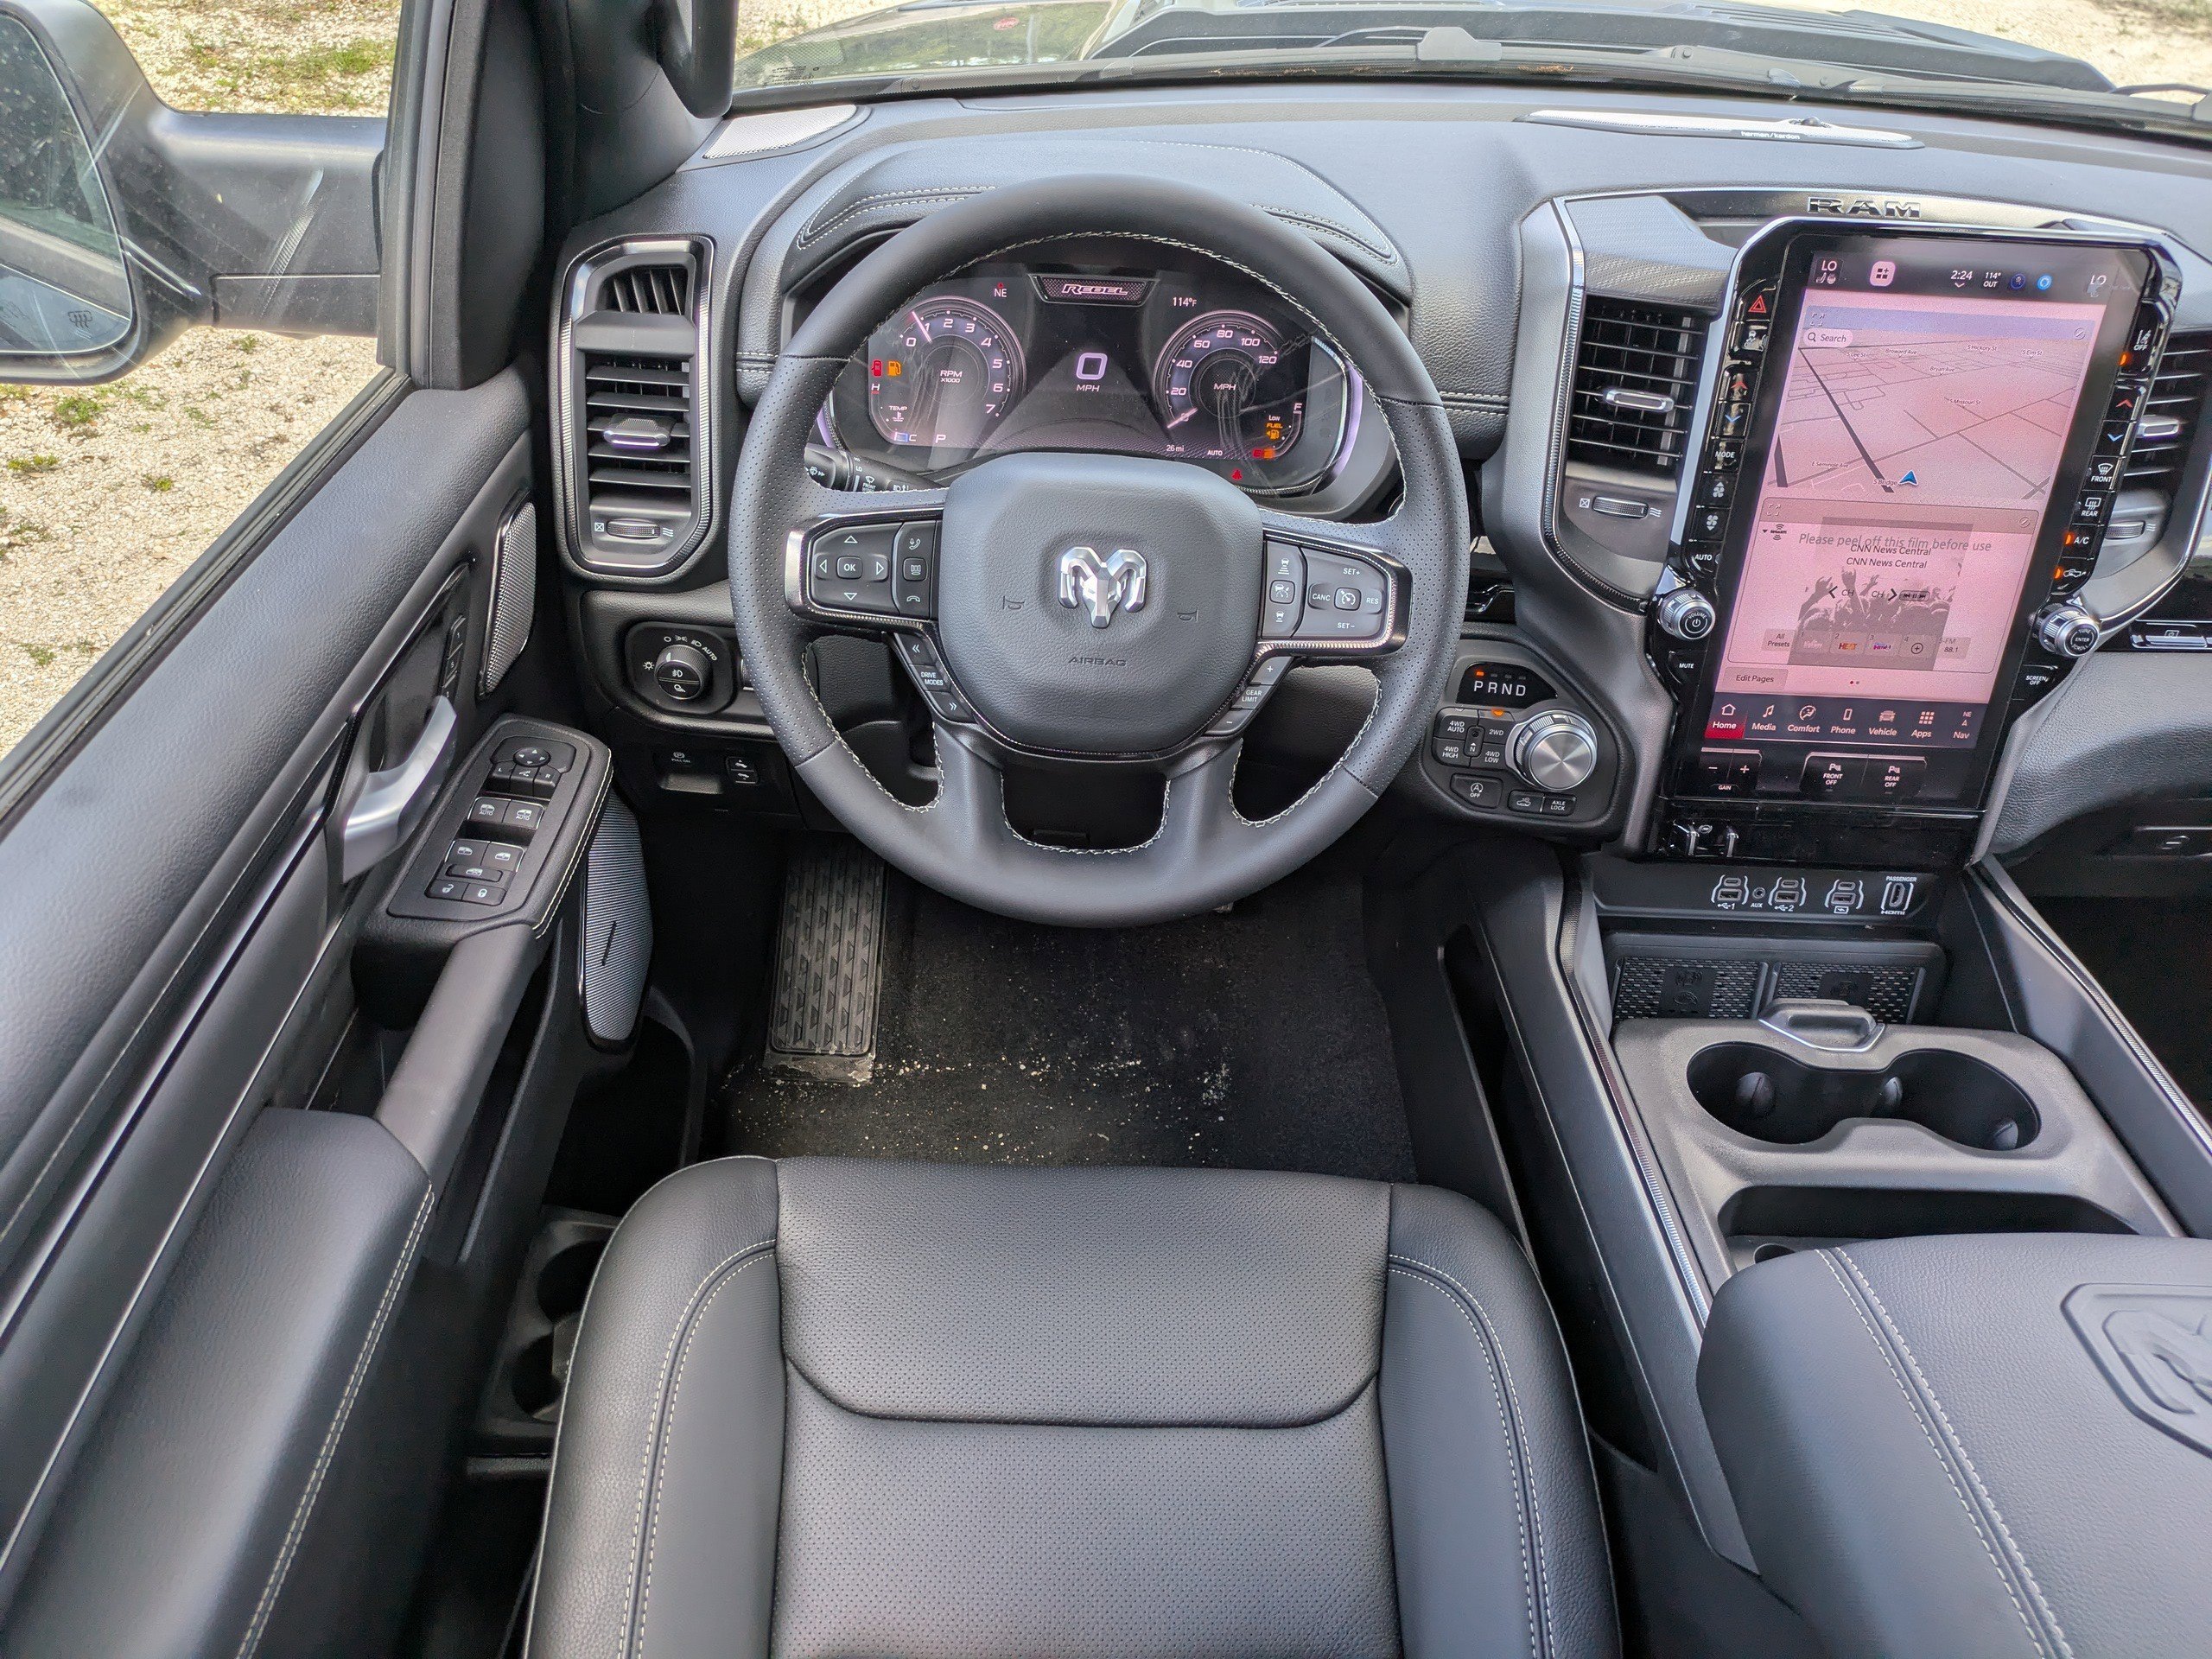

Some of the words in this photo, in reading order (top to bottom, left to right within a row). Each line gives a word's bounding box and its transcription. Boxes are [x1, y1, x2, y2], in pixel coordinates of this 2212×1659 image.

[1808, 197, 1921, 219] RAM
[1821, 260, 1838, 271] LO
[1951, 270, 1973, 281] 2:24
[994, 289, 1007, 297] NE
[1062, 283, 1128, 296] REBEL
[1173, 297, 1198, 307] 114°F
[925, 323, 931, 332] 1
[943, 319, 953, 327] 2
[965, 323, 976, 333] 3
[906, 337, 917, 346] 0
[981, 338, 992, 346] 4
[1193, 340, 1211, 348] 60
[1241, 338, 1260, 346] 100
[993, 359, 1003, 368] 5
[1076, 352, 1108, 380] 0
[1176, 359, 1192, 368] 40
[993, 384, 1003, 392] 6
[986, 404, 995, 414] 7
[935, 435, 946, 443] P
[1799, 533, 1834, 545] Please
[1837, 534, 1861, 546] peel
[1865, 536, 1882, 547] off
[1885, 536, 1904, 548] this
[1908, 537, 1929, 549] film
[1932, 538, 1968, 550] before
[1972, 542, 1992, 551] use
[2074, 536, 2089, 544] A/C
[1850, 544, 1872, 553] CNN
[1898, 547, 1931, 556] Central
[1694, 553, 1713, 562] AUTO
[843, 563, 856, 572] OK
[1869, 558, 1893, 567] News
[1895, 559, 1927, 569] Central
[702, 646, 717, 661] AUTO
[1068, 657, 1127, 667] AIRBAG
[1751, 675, 1774, 684] Pages
[1473, 680, 1484, 691] P
[1487, 682, 1497, 694] R
[1501, 683, 1512, 696] N
[1516, 684, 1526, 696] D
[1751, 722, 1777, 731] Media
[1788, 724, 1820, 733] Comfort
[1830, 726, 1856, 734] Phone
[1868, 728, 1897, 736] Vehicle
[1911, 729, 1932, 739] Apps
